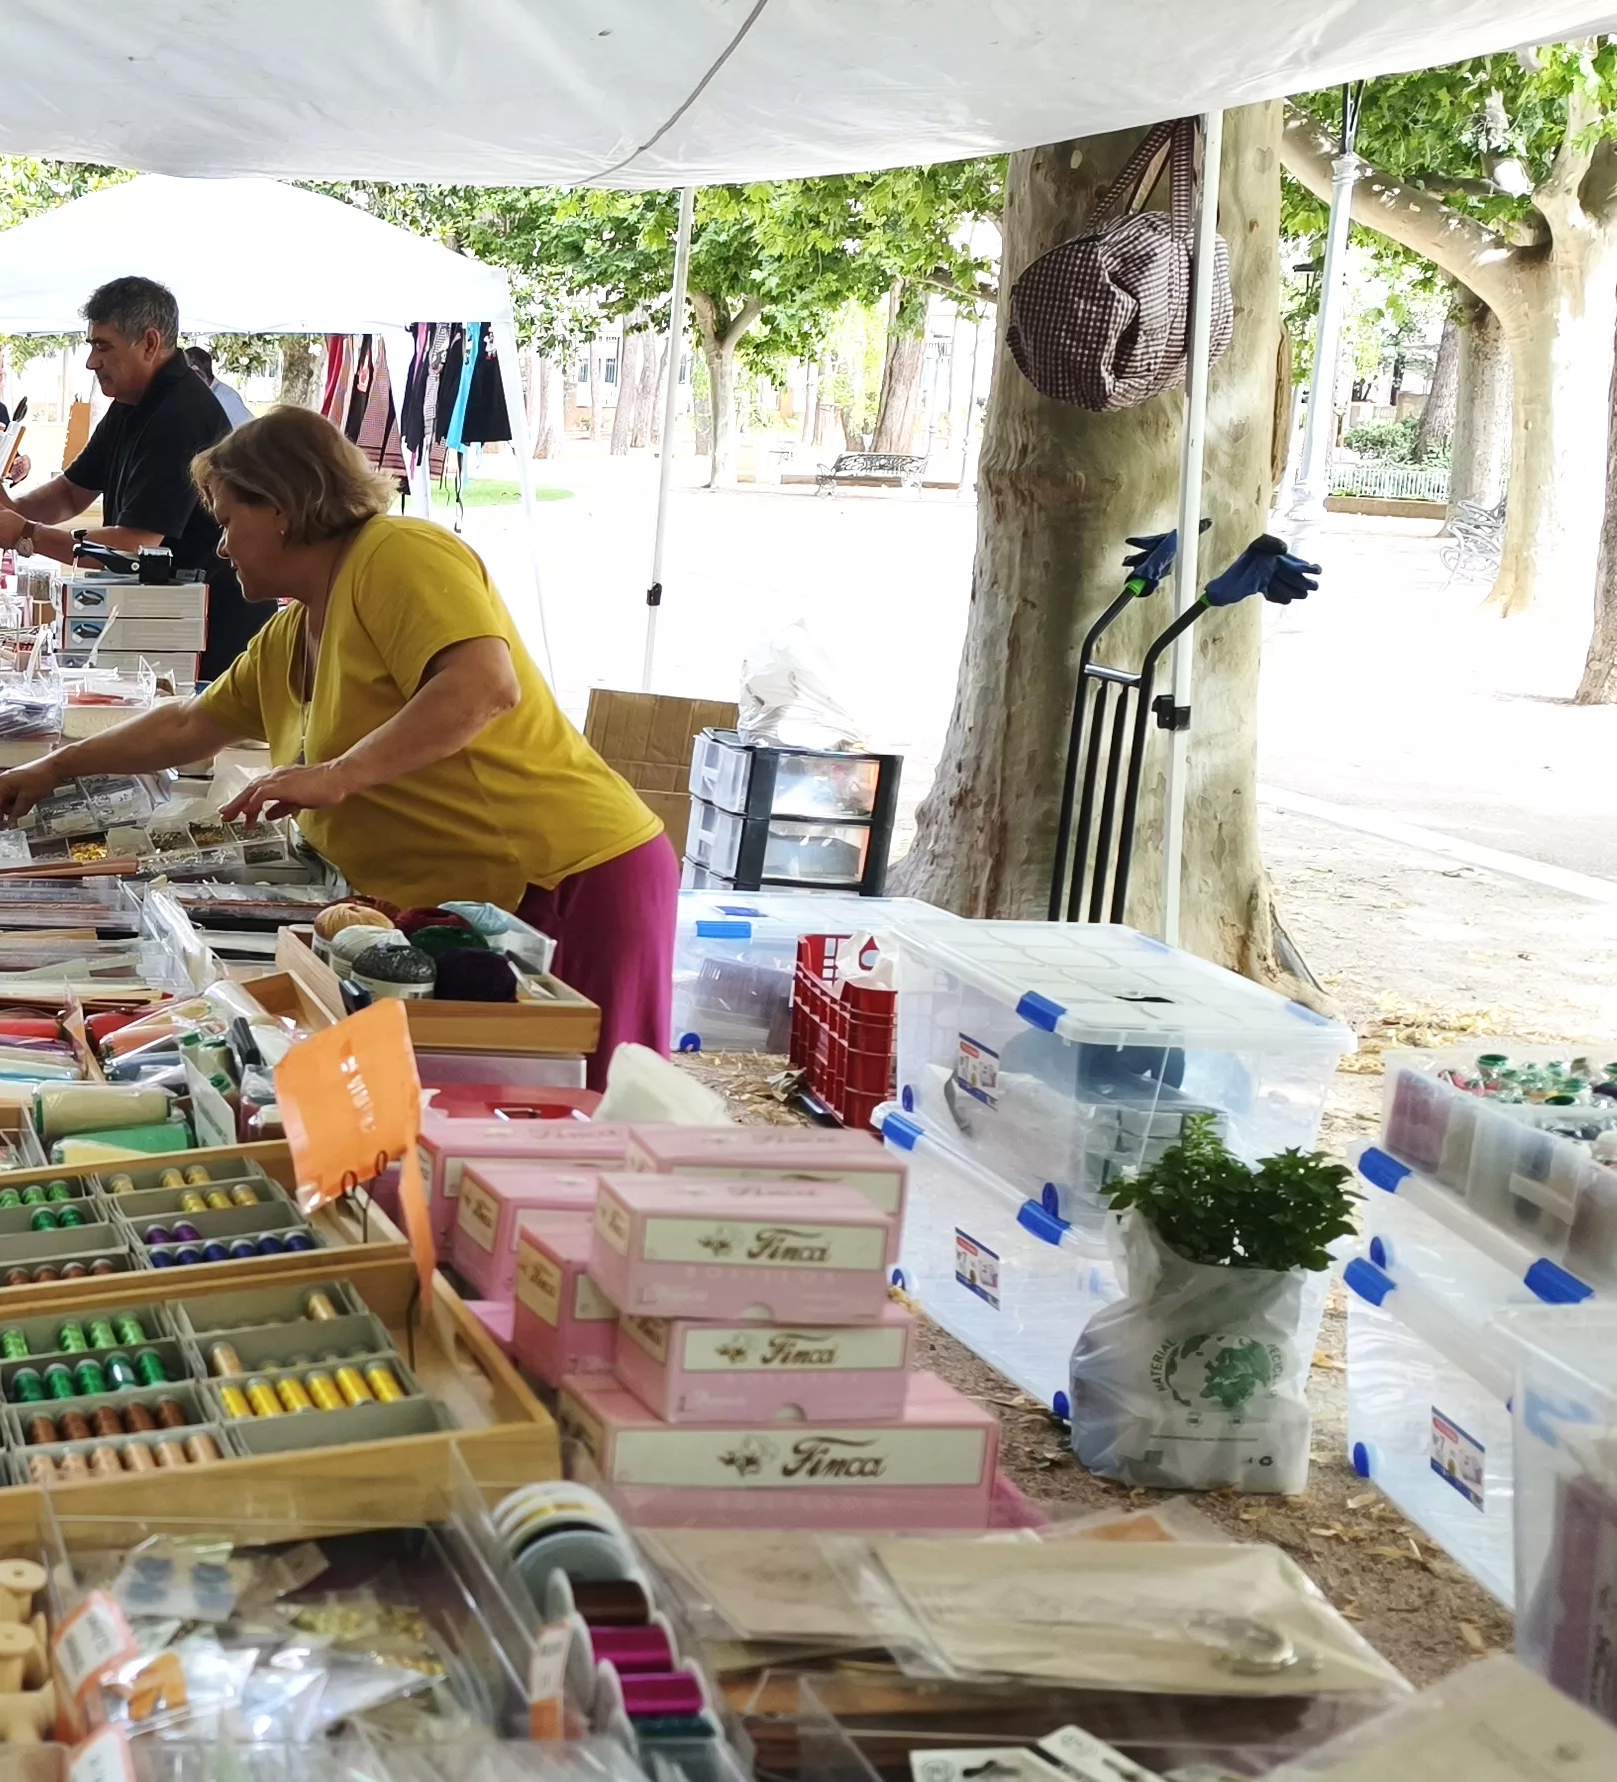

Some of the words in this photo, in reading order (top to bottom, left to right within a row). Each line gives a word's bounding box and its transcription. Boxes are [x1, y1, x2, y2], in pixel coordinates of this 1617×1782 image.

[746, 1227, 832, 1262] Finca
[760, 1333, 840, 1365] Finca
[1150, 1338, 1178, 1392] MATERIAL
[781, 1435, 888, 1479] Finca
